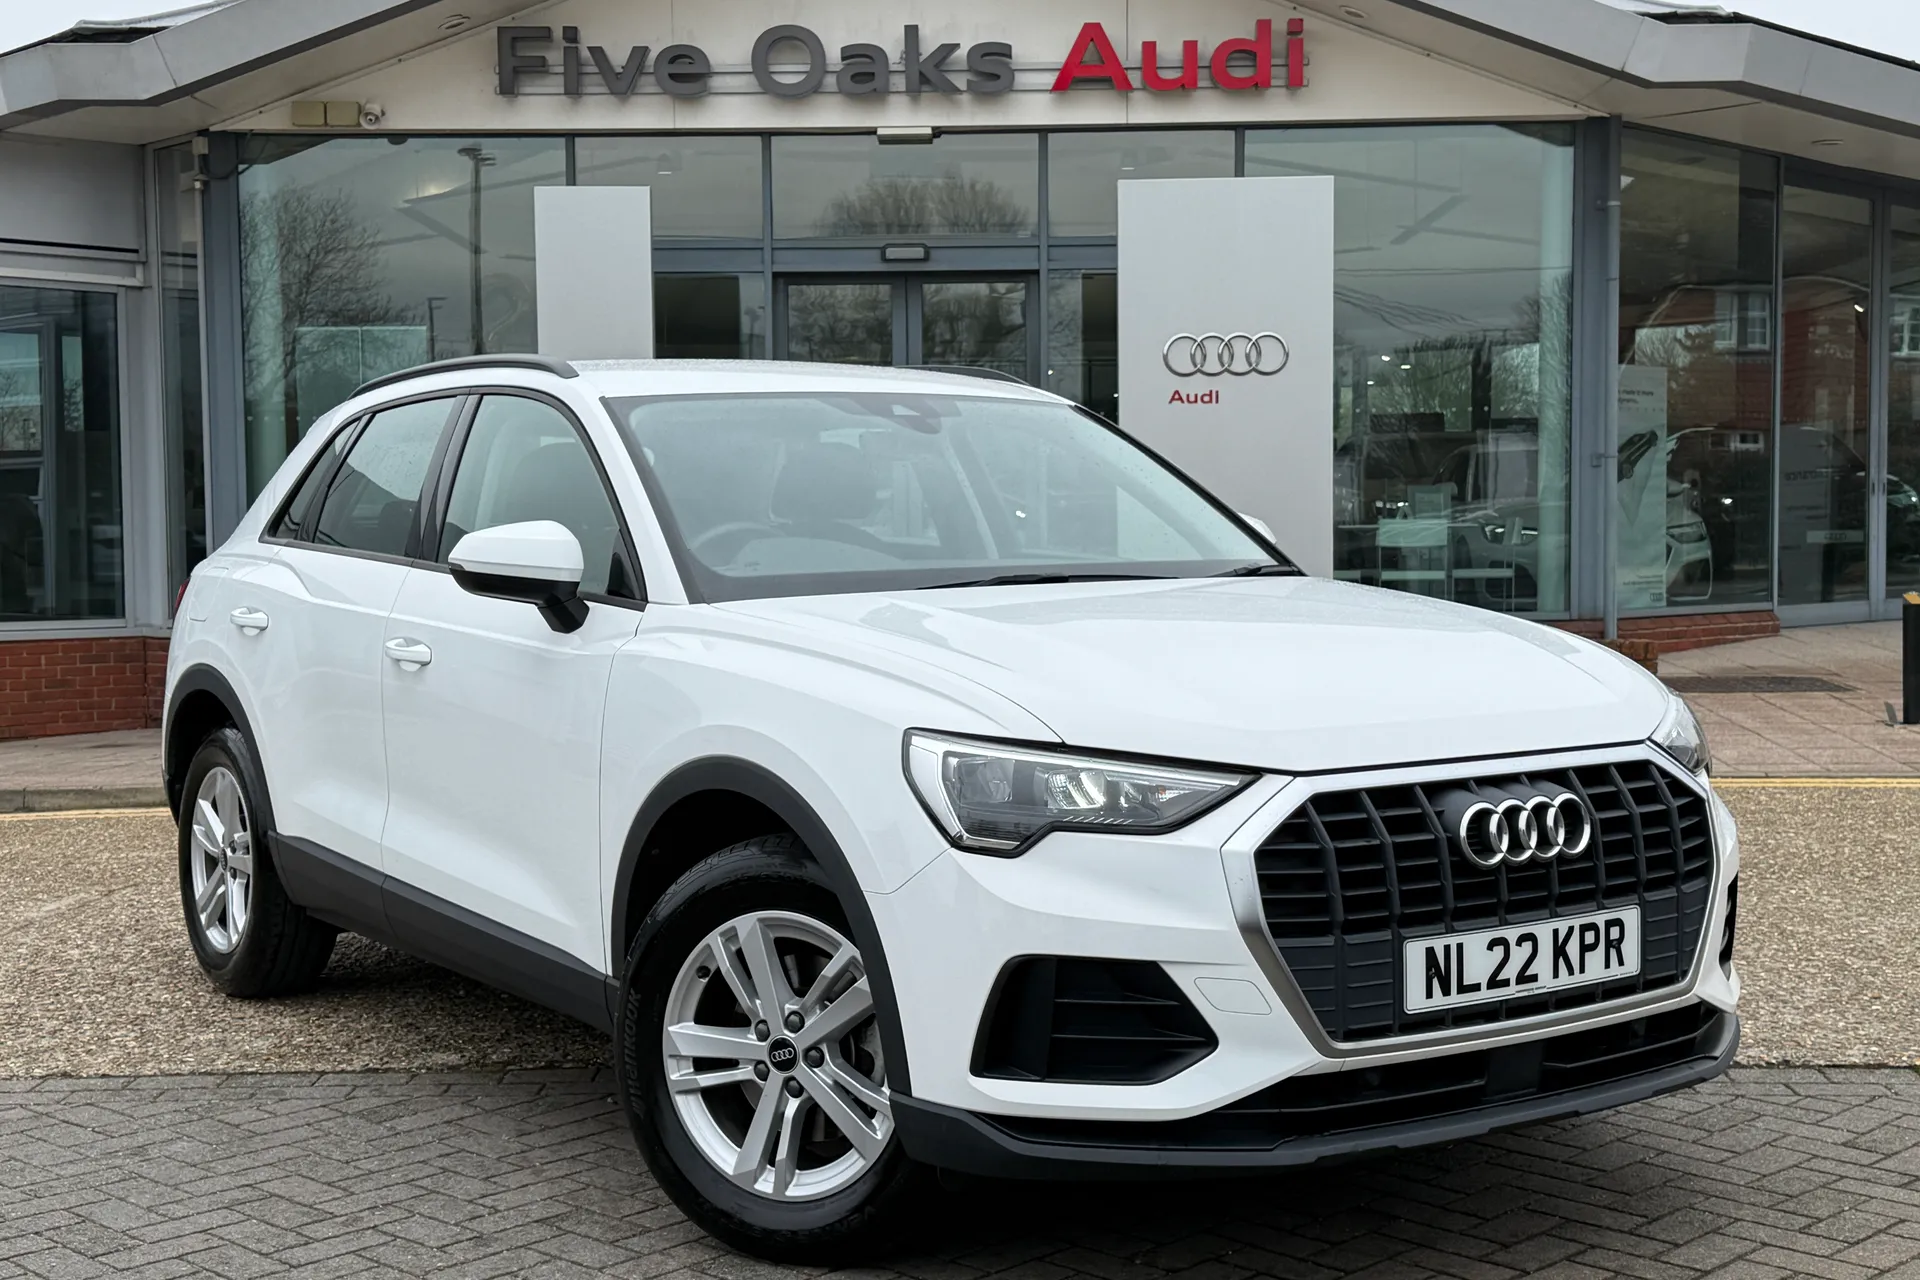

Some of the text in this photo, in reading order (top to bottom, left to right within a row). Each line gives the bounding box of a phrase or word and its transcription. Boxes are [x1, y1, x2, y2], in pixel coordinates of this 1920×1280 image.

[496, 18, 1307, 98] Five Oaks Audi
[1168, 389, 1219, 404] Audi
[1425, 917, 1625, 1000] NL22 KPR
